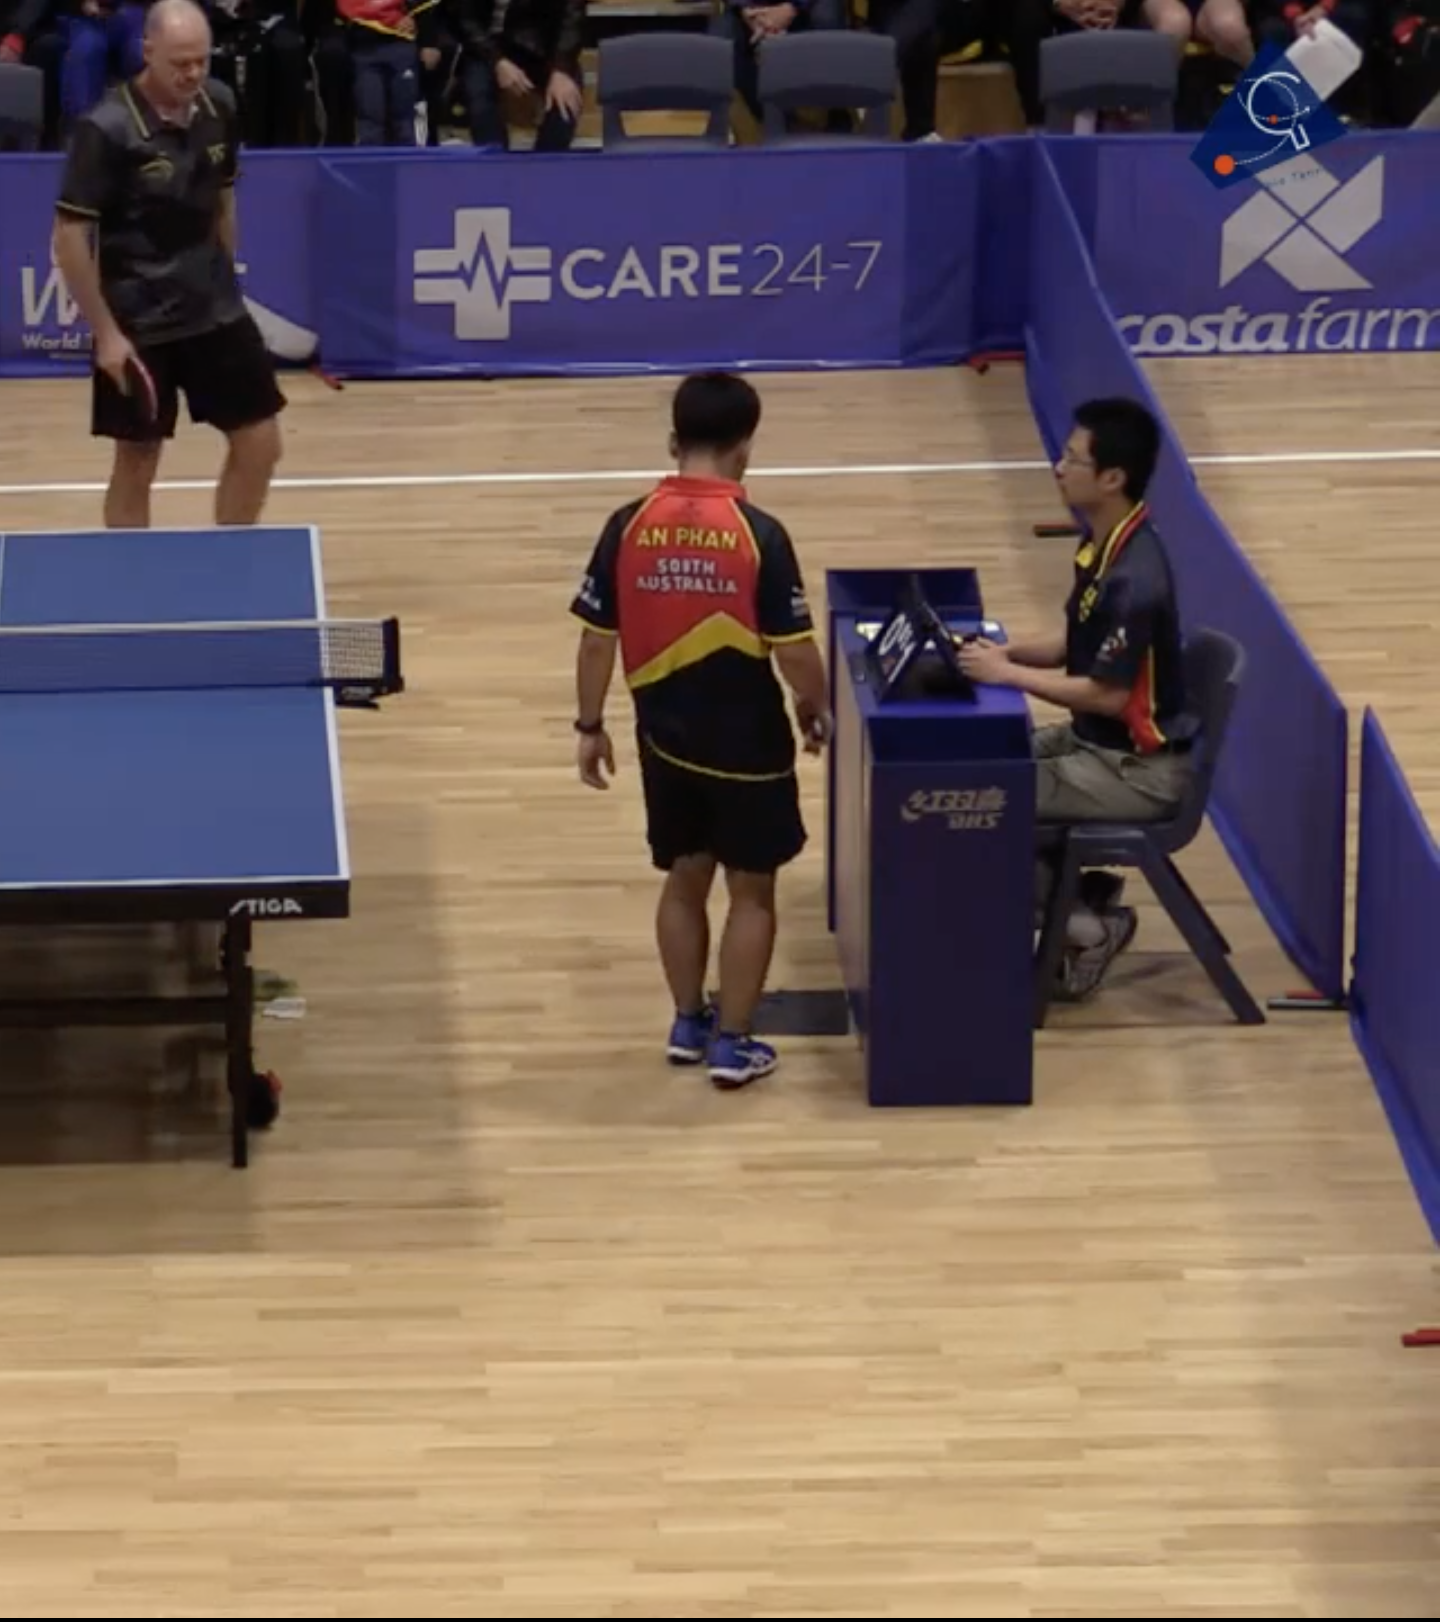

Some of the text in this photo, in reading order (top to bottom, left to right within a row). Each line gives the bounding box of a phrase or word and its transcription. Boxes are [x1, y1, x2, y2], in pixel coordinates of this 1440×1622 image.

[21, 331, 80, 350] World
[635, 527, 739, 550] AN PHAN
[636, 575, 739, 595] AUSTRALIA
[229, 897, 303, 917] STIGA
